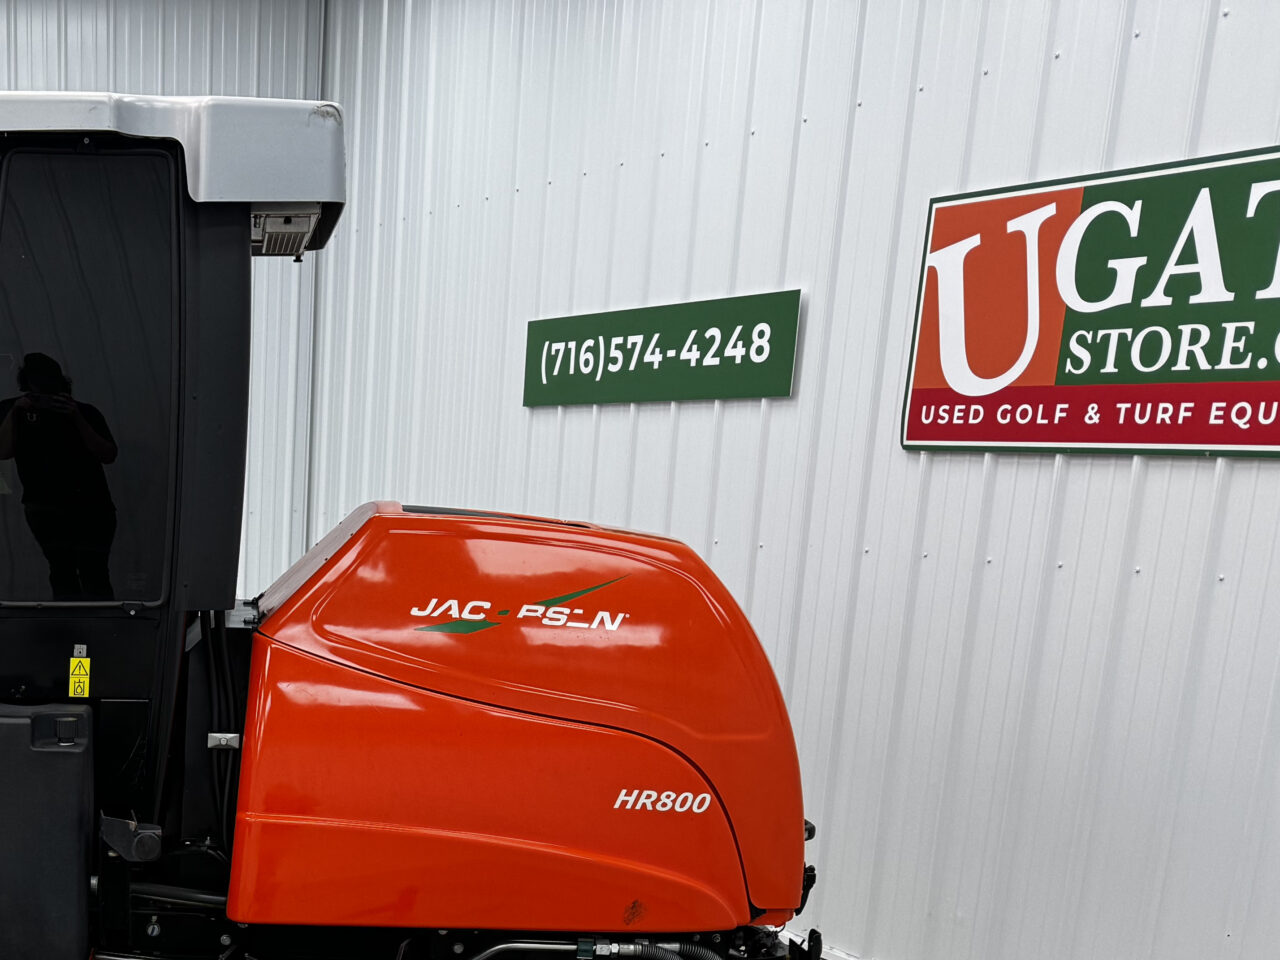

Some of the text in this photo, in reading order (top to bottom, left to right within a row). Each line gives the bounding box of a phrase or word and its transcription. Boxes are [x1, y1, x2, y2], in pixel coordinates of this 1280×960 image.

[541, 322, 771, 384] (716)574-4248
[1065, 321, 1280, 375] STORE.
[920, 401, 1279, 430] USED GOLF & TURF EQU
[613, 788, 712, 813] HR800
